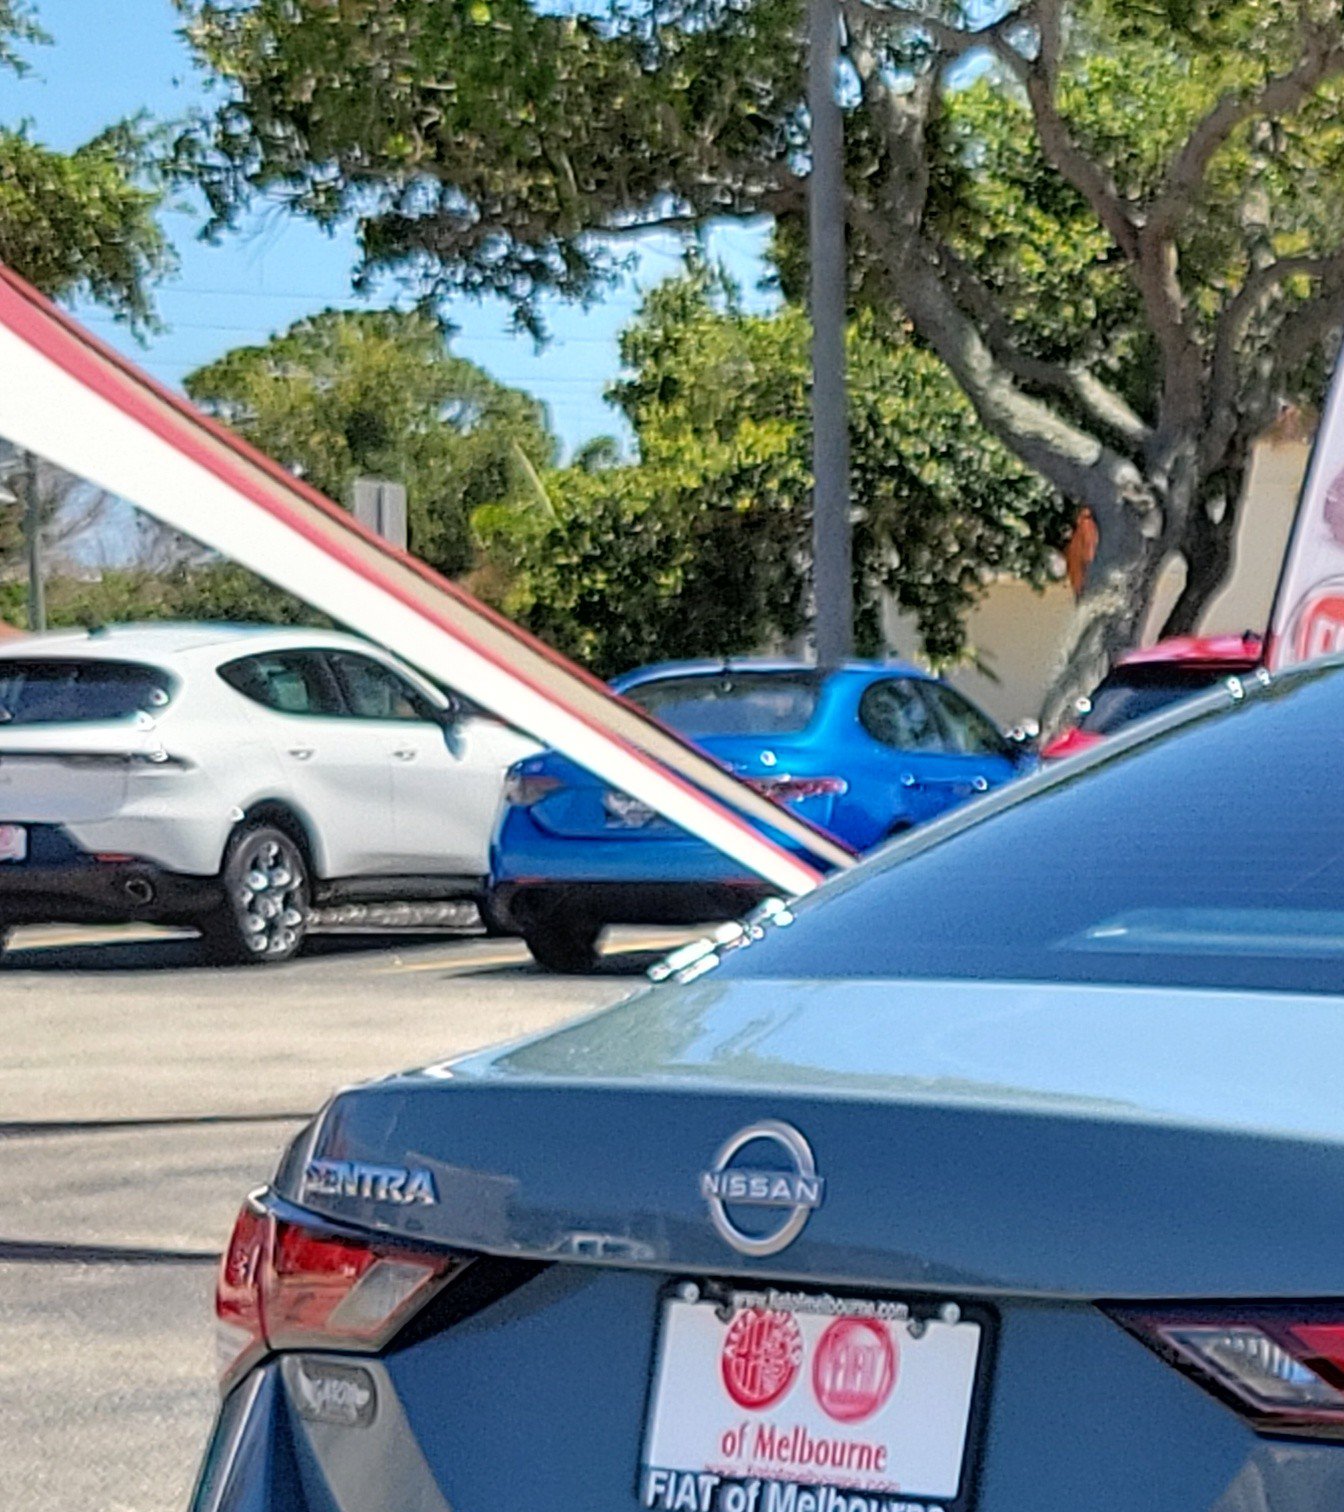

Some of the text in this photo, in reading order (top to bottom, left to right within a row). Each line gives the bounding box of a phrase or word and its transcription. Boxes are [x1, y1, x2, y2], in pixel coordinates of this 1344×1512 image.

[703, 1172, 820, 1206] NISSAN
[722, 1421, 888, 1472] of Melbourne
